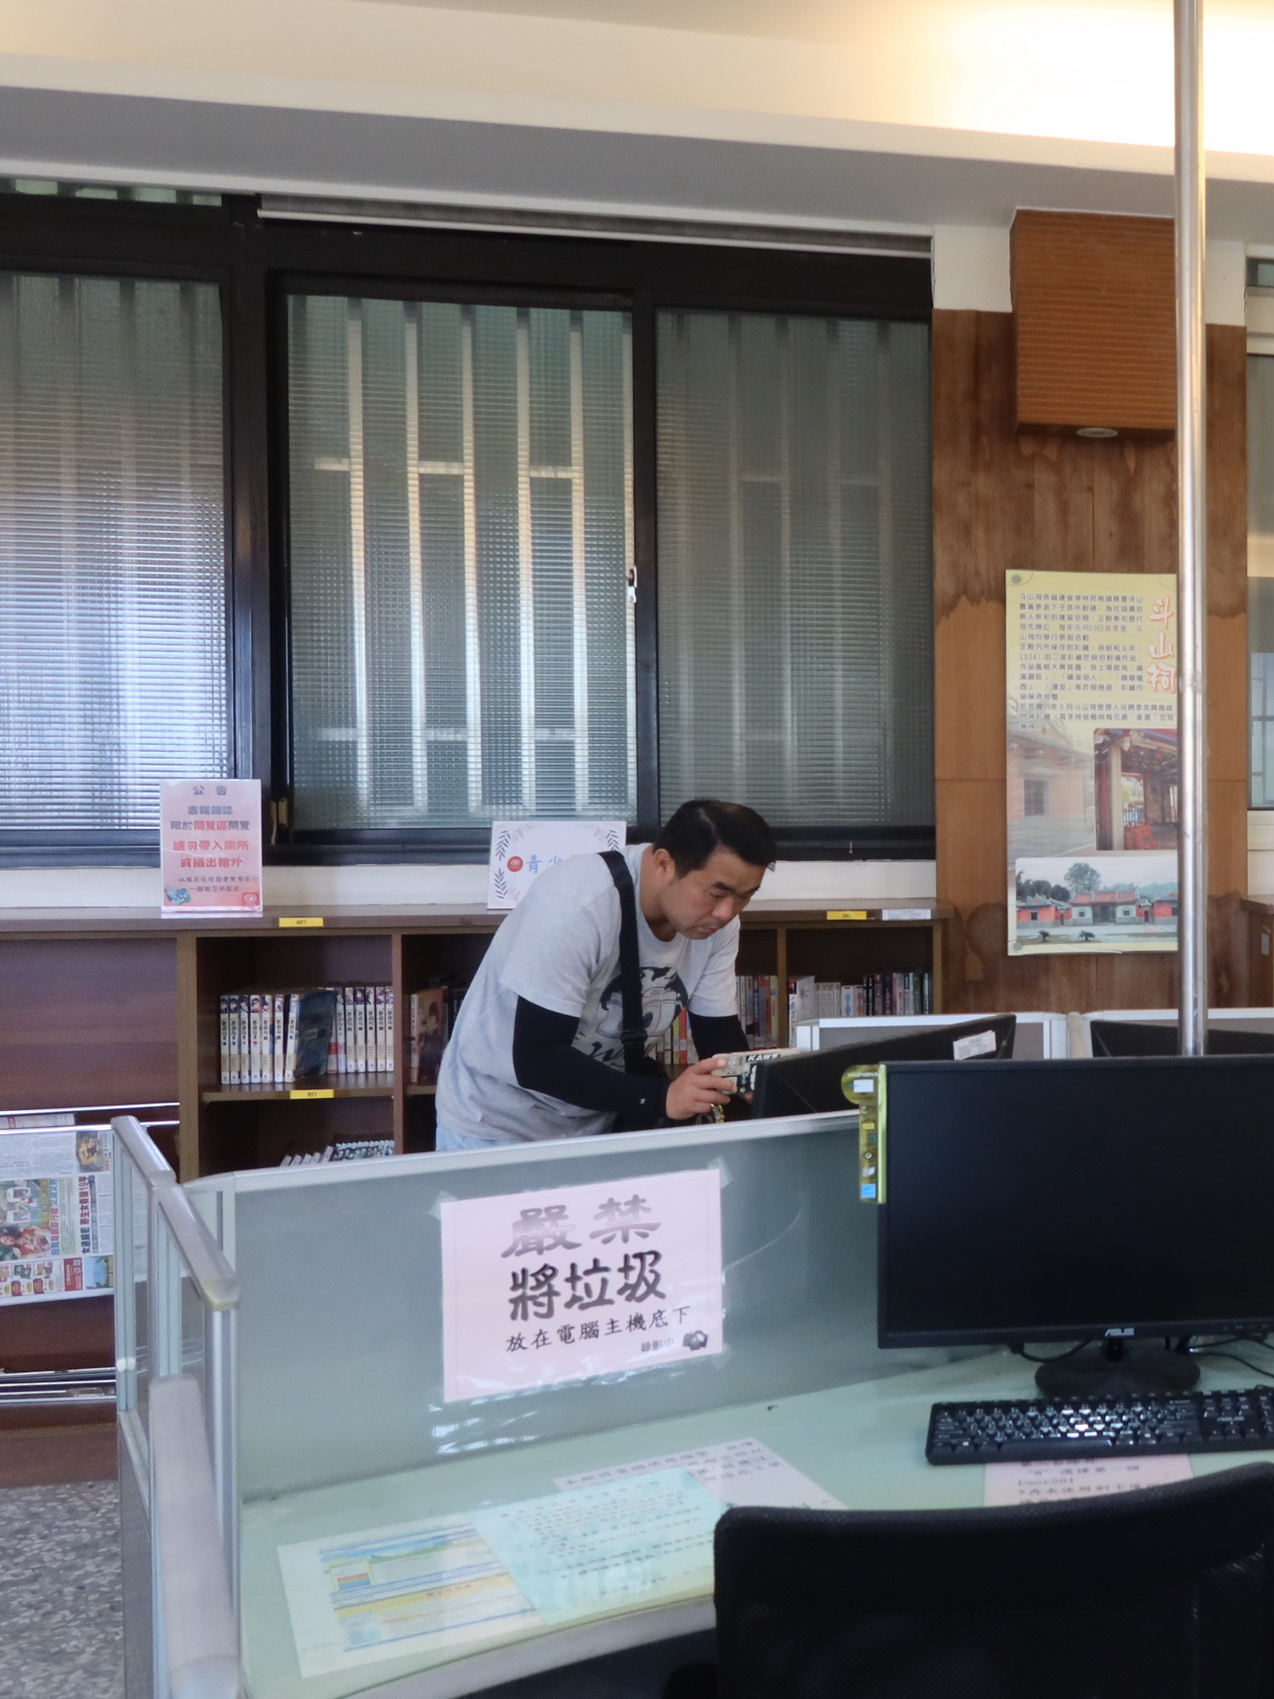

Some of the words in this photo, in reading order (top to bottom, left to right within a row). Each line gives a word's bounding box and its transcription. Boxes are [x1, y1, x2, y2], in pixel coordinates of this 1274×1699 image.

[500, 1194, 662, 1258] 嚴禁
[508, 1250, 667, 1322] 將垃圾
[505, 1305, 692, 1353] 放在電腦主機底下
[640, 1337, 674, 1353] 錄影中
